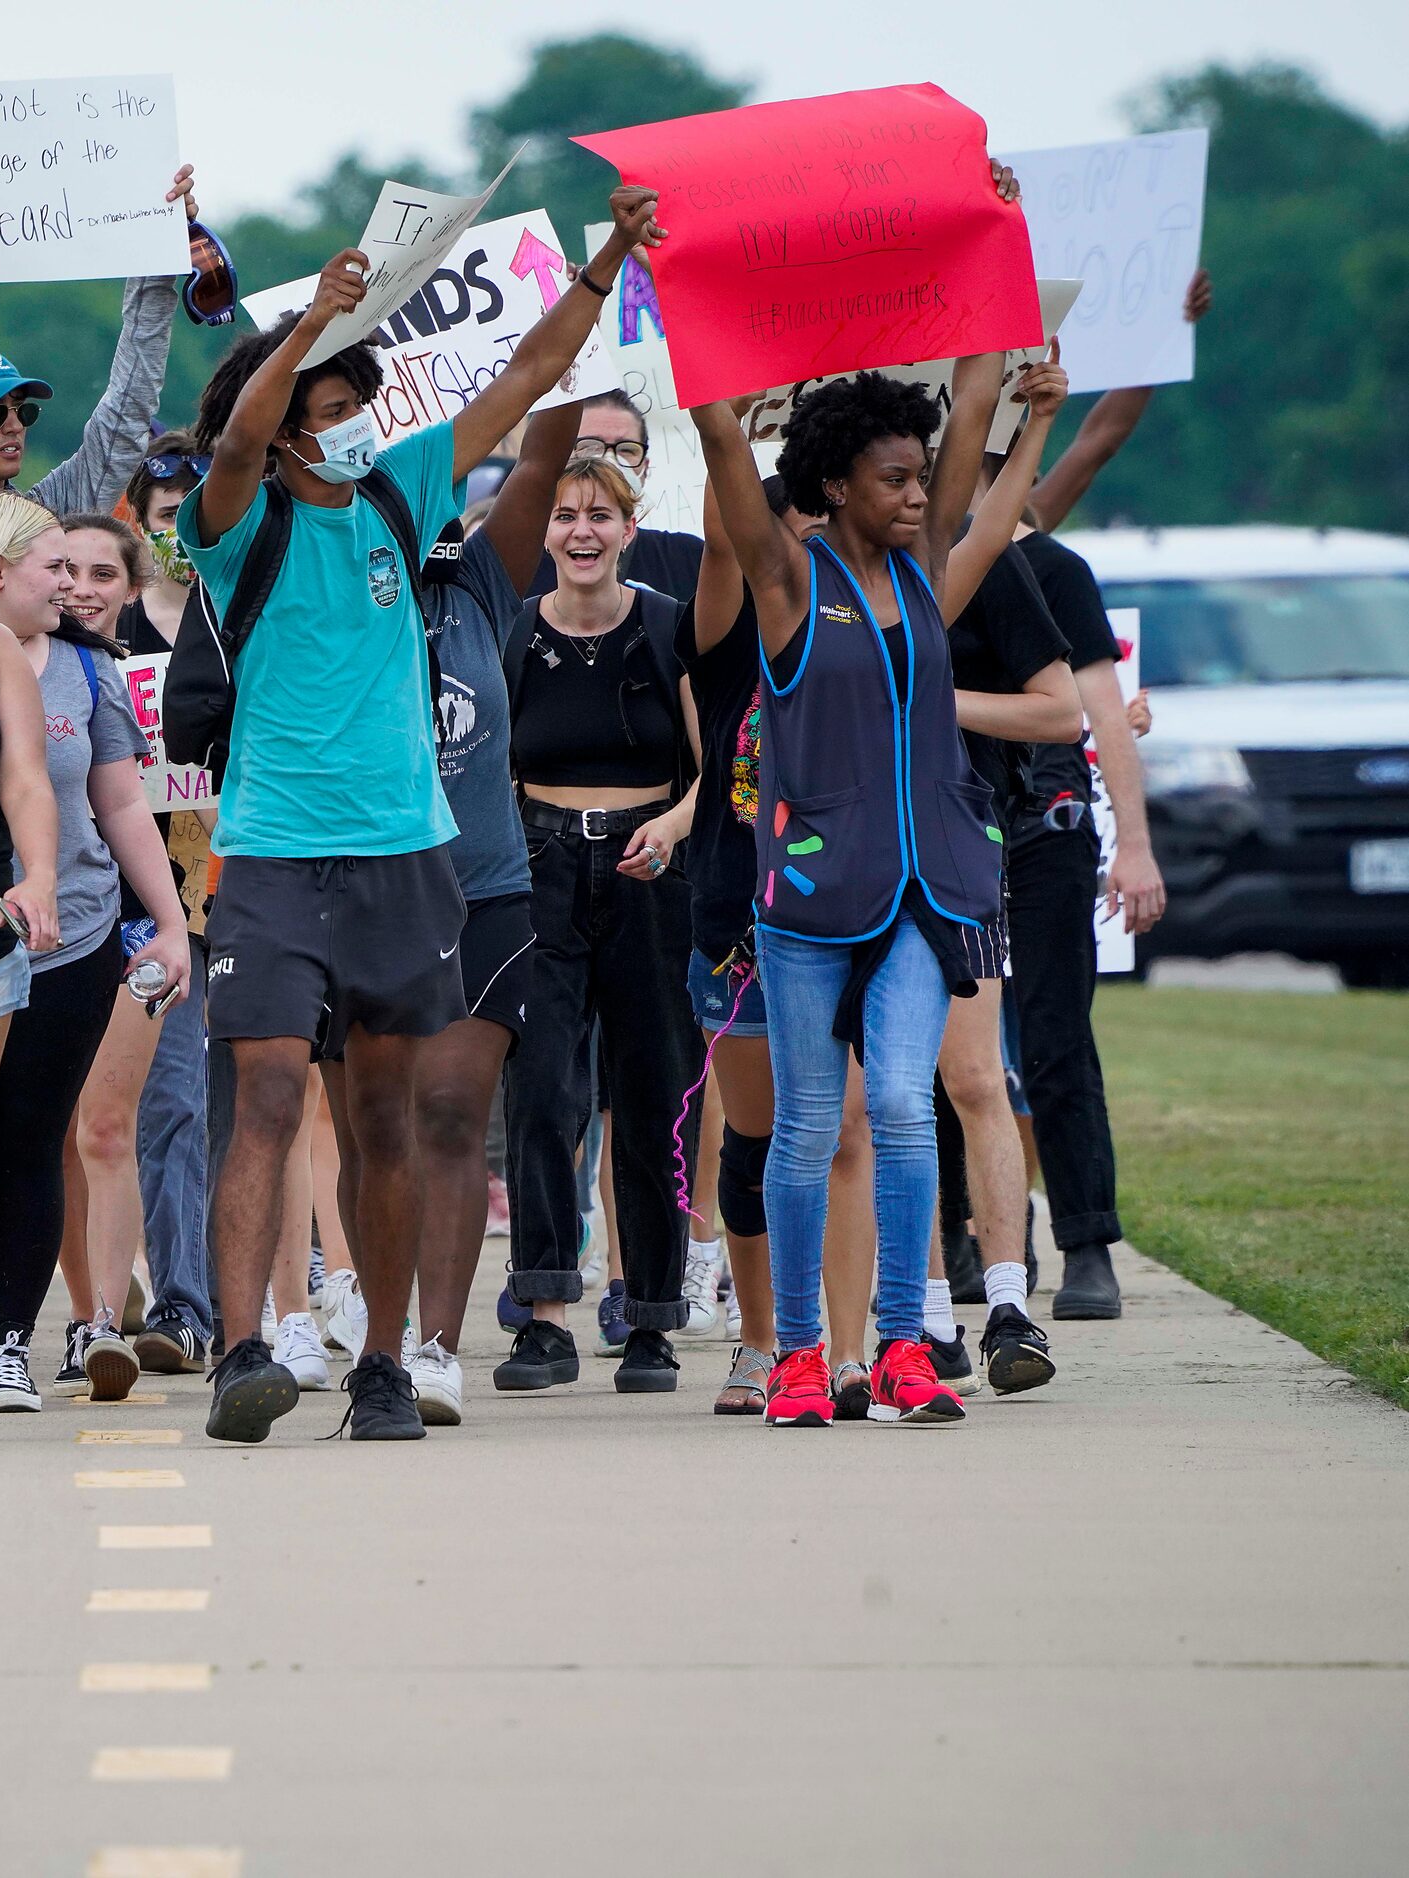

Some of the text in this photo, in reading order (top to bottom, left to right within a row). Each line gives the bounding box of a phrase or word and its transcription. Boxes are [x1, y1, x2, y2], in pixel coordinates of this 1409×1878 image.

[76, 93, 99, 119] is
[112, 89, 156, 118] the
[41, 140, 64, 170] of
[82, 139, 119, 164] the
[834, 157, 909, 189] than
[372, 199, 433, 247] If
[819, 605, 851, 618] Walmart
[826, 614, 852, 624] Associate
[835, 604, 851, 612] Proud
[208, 957, 234, 982] SMU
